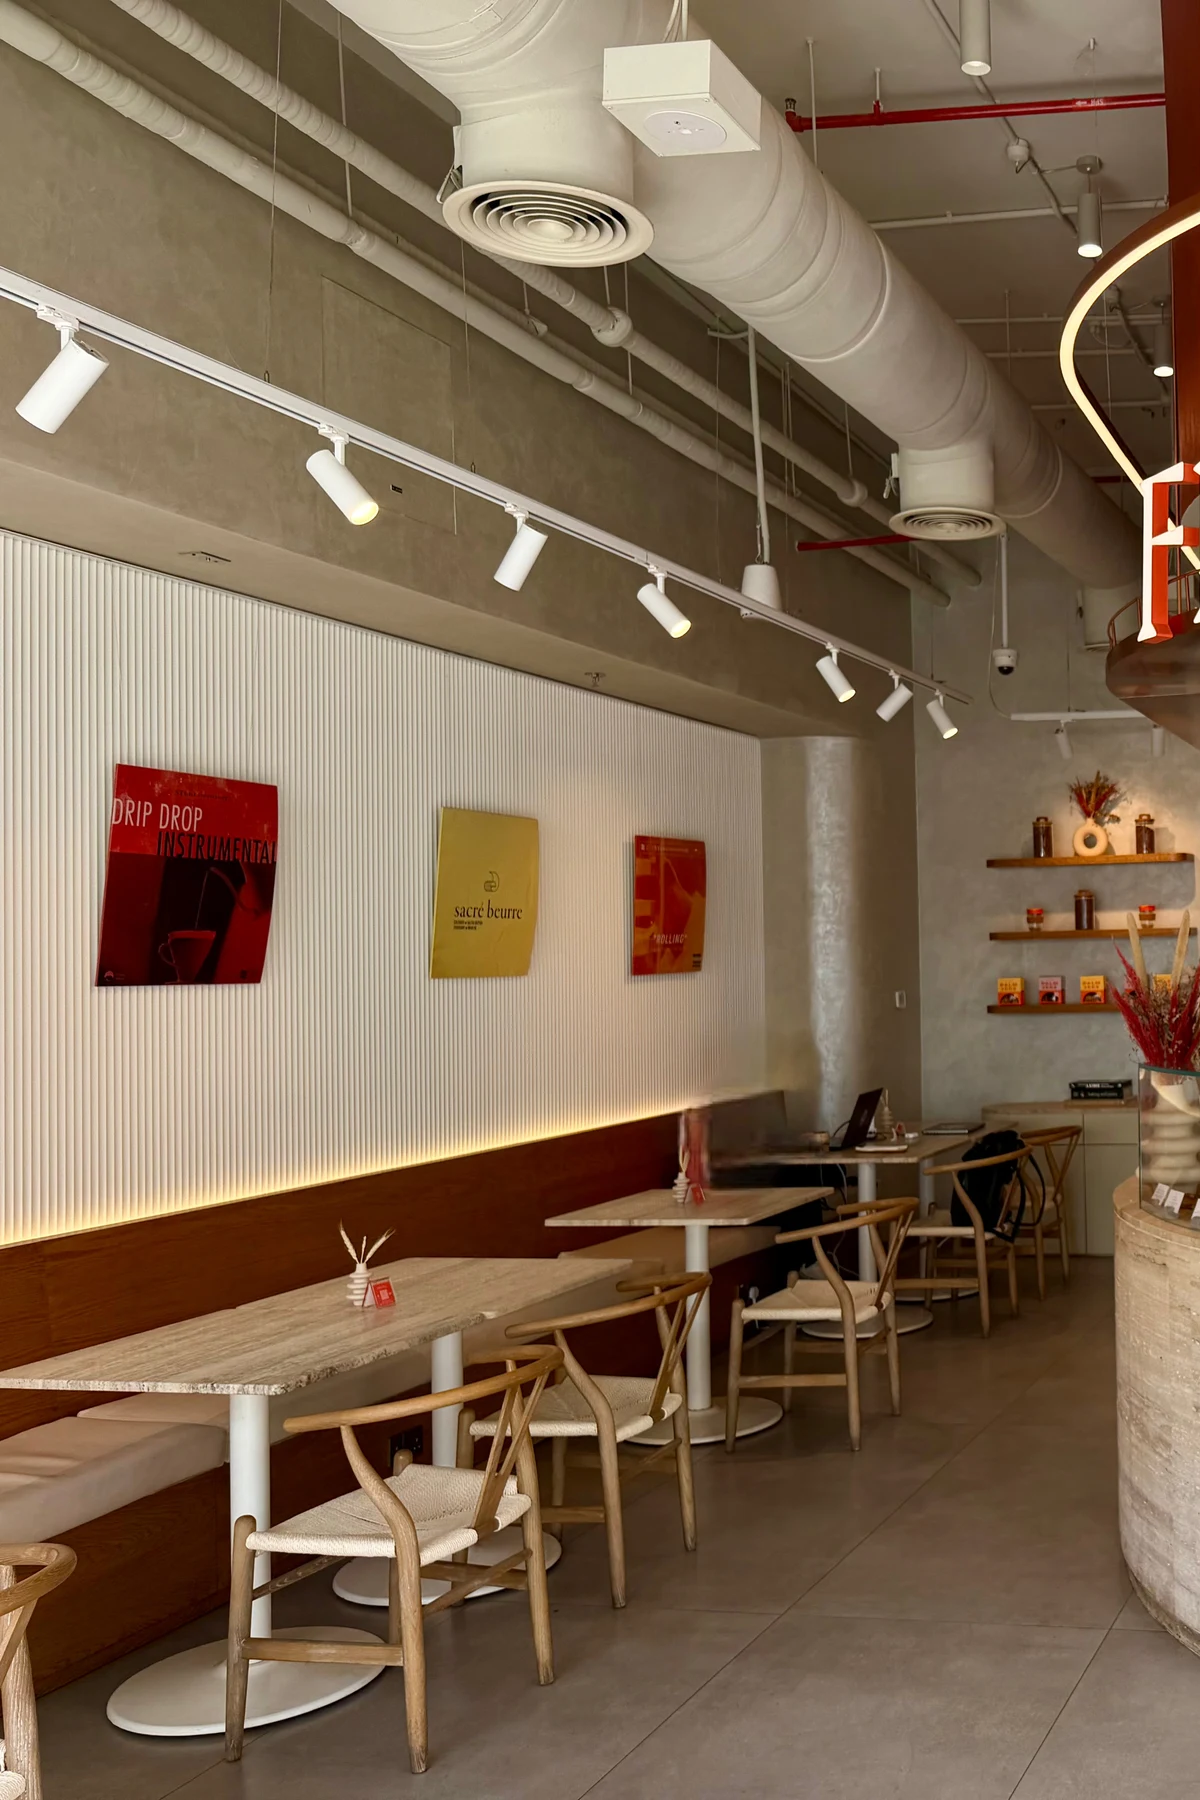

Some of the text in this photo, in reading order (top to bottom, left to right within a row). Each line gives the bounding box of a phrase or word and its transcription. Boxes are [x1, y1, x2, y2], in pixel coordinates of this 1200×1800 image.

[111, 797, 203, 833] DRIP DROP
[453, 899, 523, 920] sacré beurre
